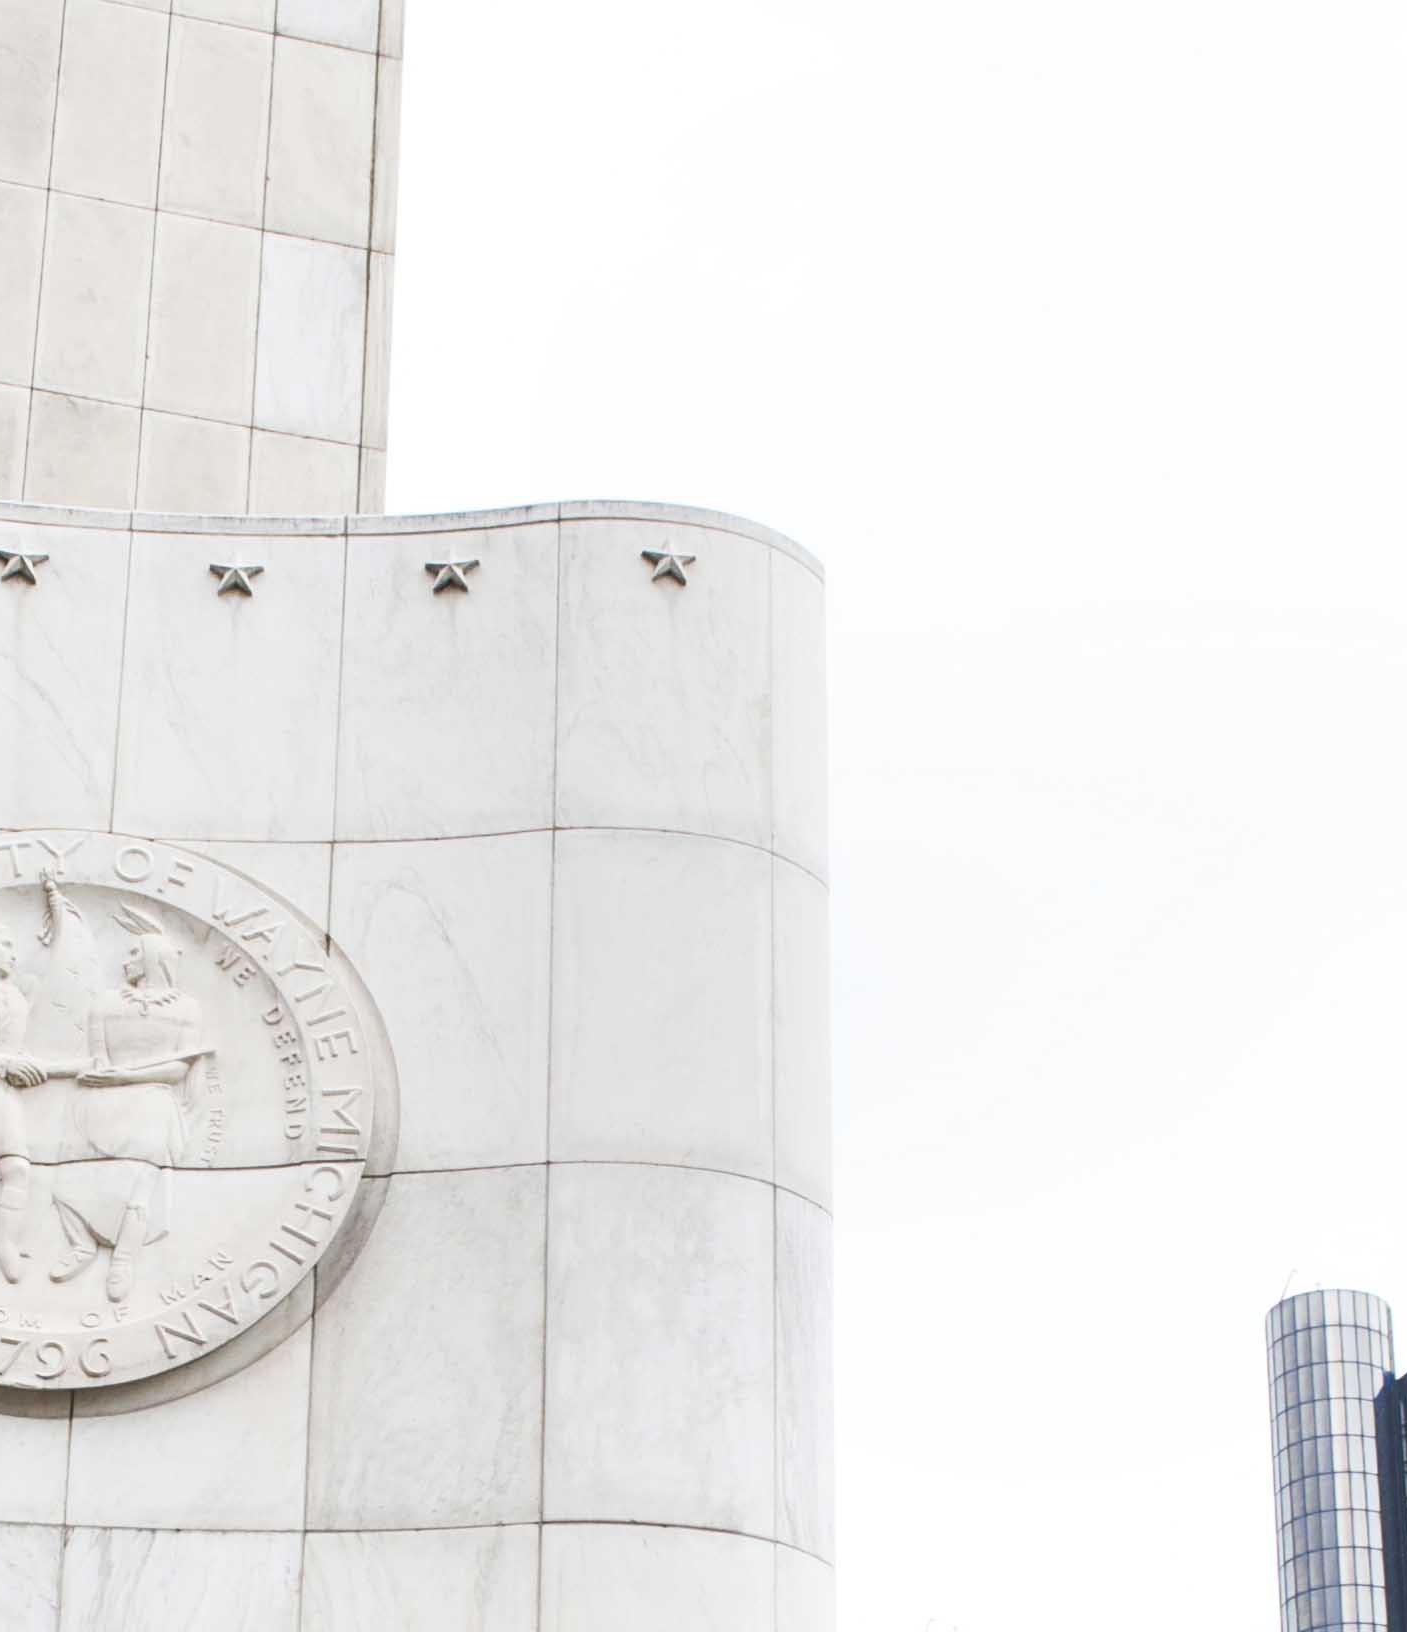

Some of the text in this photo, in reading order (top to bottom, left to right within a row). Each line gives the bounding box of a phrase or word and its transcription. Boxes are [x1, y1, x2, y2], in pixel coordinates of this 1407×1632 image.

[115, 846, 196, 895] OF
[211, 873, 362, 1063] WAYNE
[261, 1005, 308, 1141] DEFEND
[78, 1304, 131, 1329] OF
[159, 1251, 235, 1306] MAN
[154, 1087, 364, 1359] MICHIGAN
